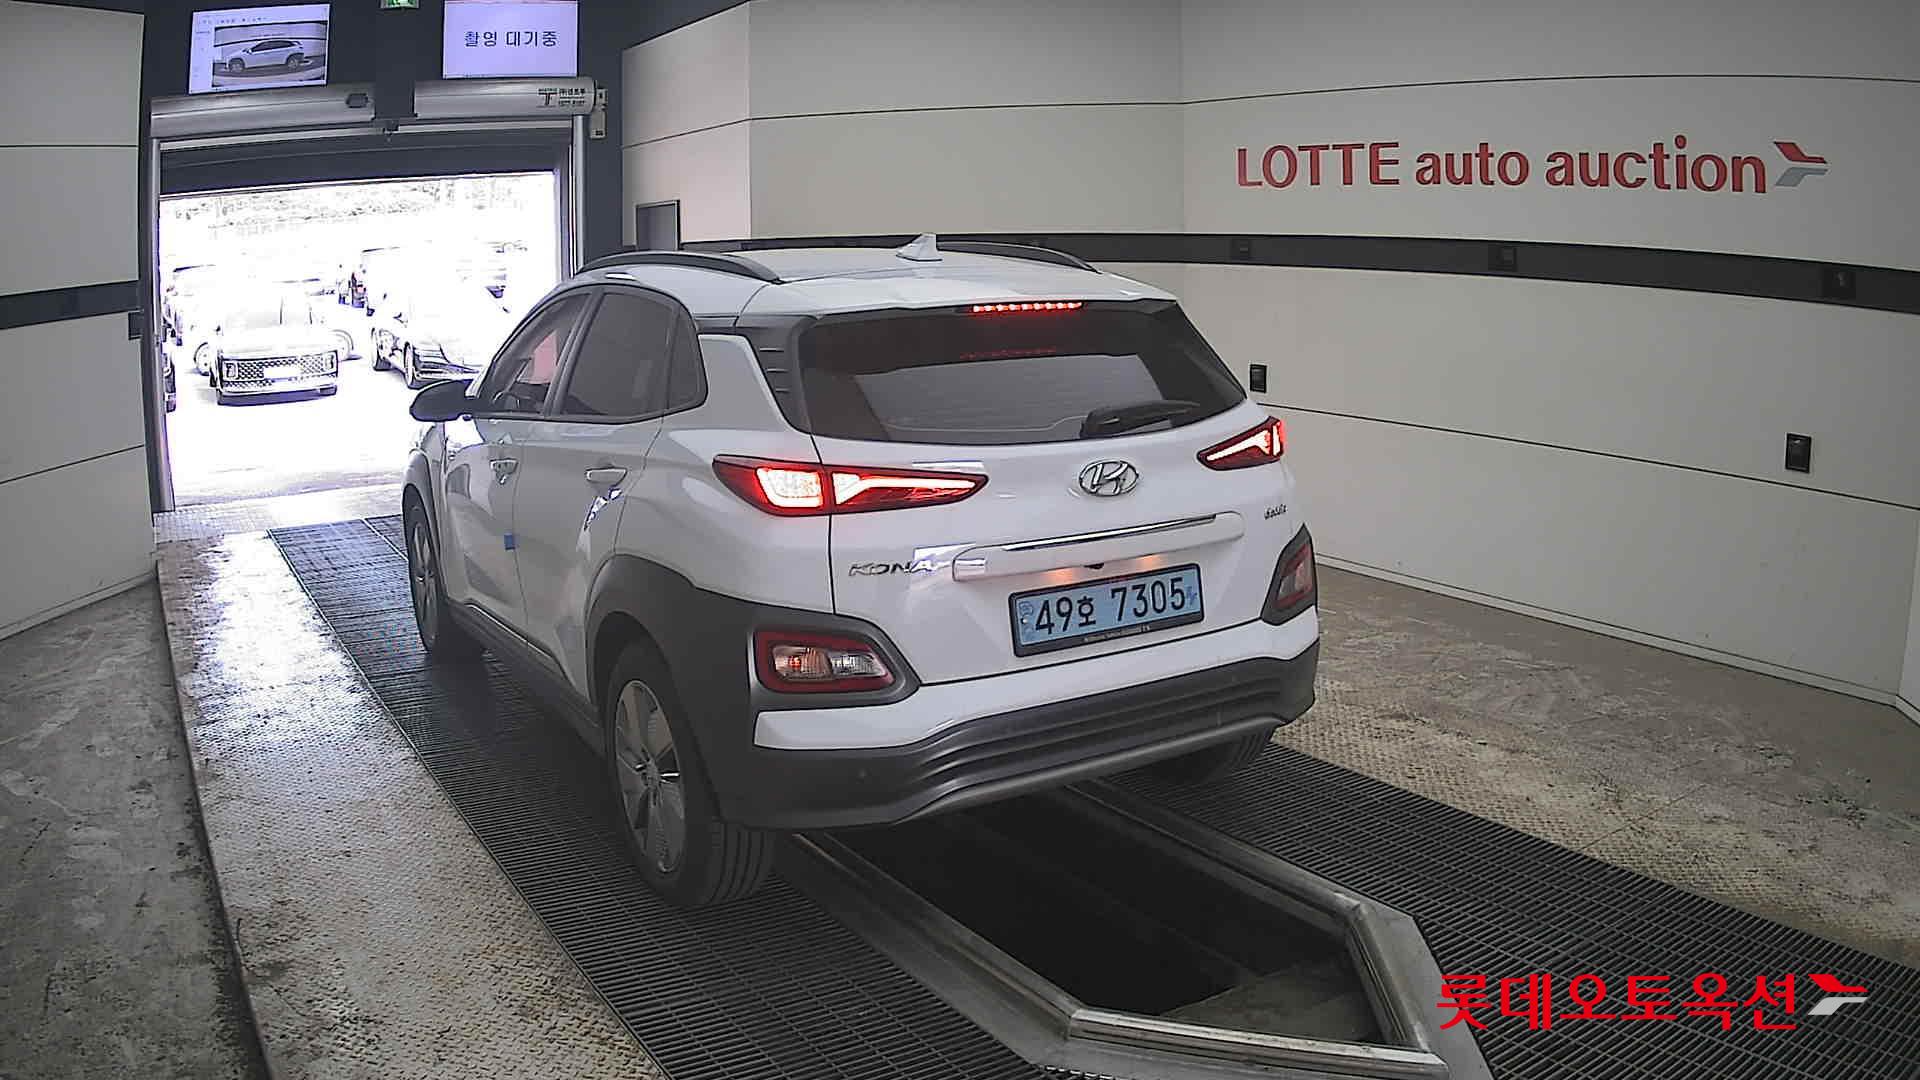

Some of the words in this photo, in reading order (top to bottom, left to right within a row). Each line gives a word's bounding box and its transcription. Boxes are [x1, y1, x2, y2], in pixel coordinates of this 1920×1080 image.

[464, 31, 498, 48] 촬영
[506, 31, 558, 48] 대기중
[1237, 142, 1400, 188] LOTTE
[1415, 142, 1530, 186] auto
[1545, 134, 1767, 194] auction
[848, 559, 932, 577] KONA
[1035, 595, 1096, 635] 49호
[1111, 577, 1186, 622] 7305
